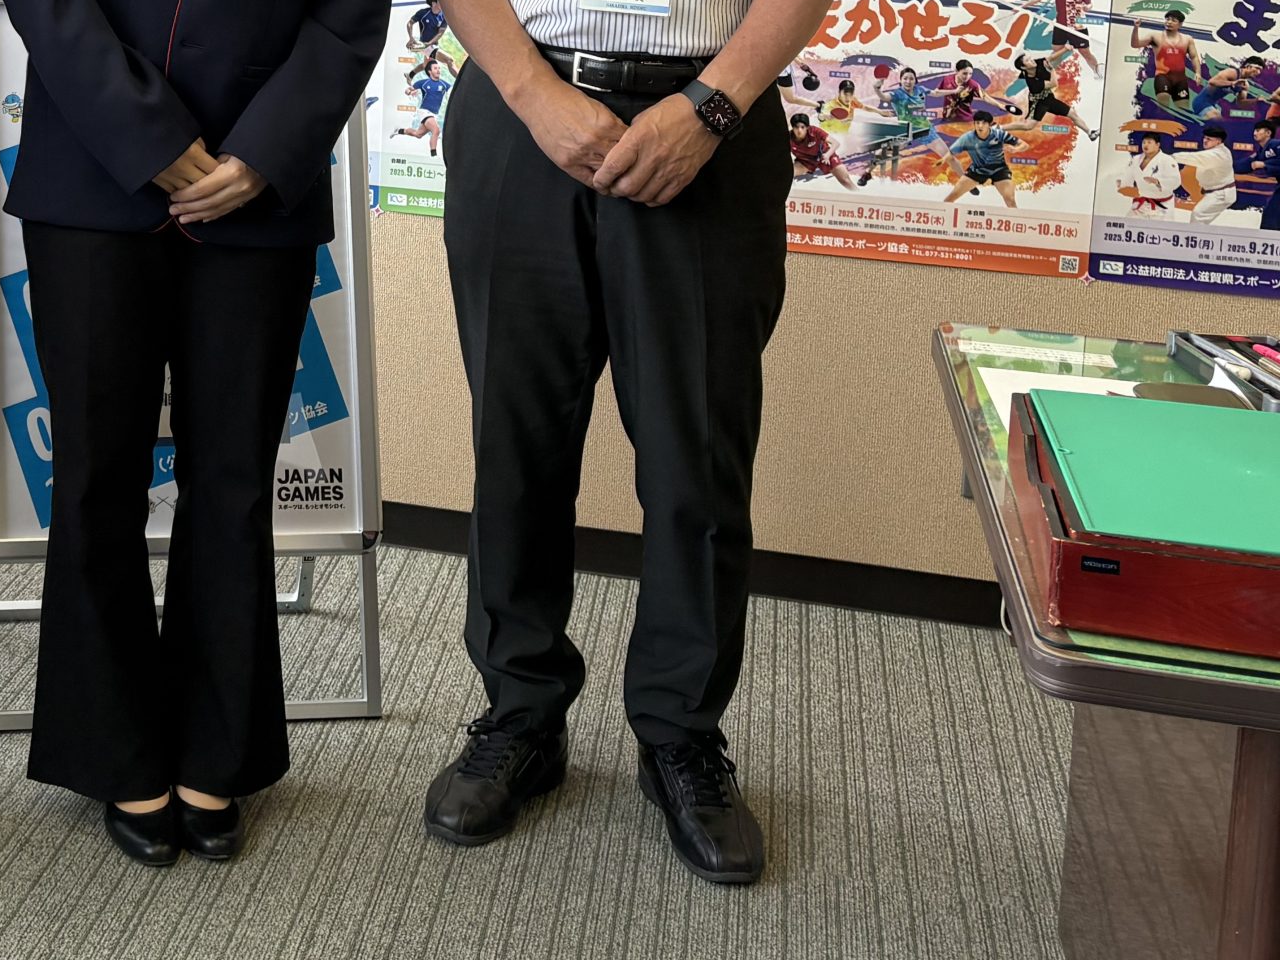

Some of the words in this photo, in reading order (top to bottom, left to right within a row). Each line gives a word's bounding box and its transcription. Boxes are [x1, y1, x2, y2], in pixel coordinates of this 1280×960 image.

[1142, 2, 1171, 11] レスリング
[786, 231, 910, 254] 法人滋賀県スポーツ協会
[1227, 241, 1280, 257] 2025.9.21(
[277, 468, 343, 485] JAPAN
[277, 486, 344, 502] GAMES
